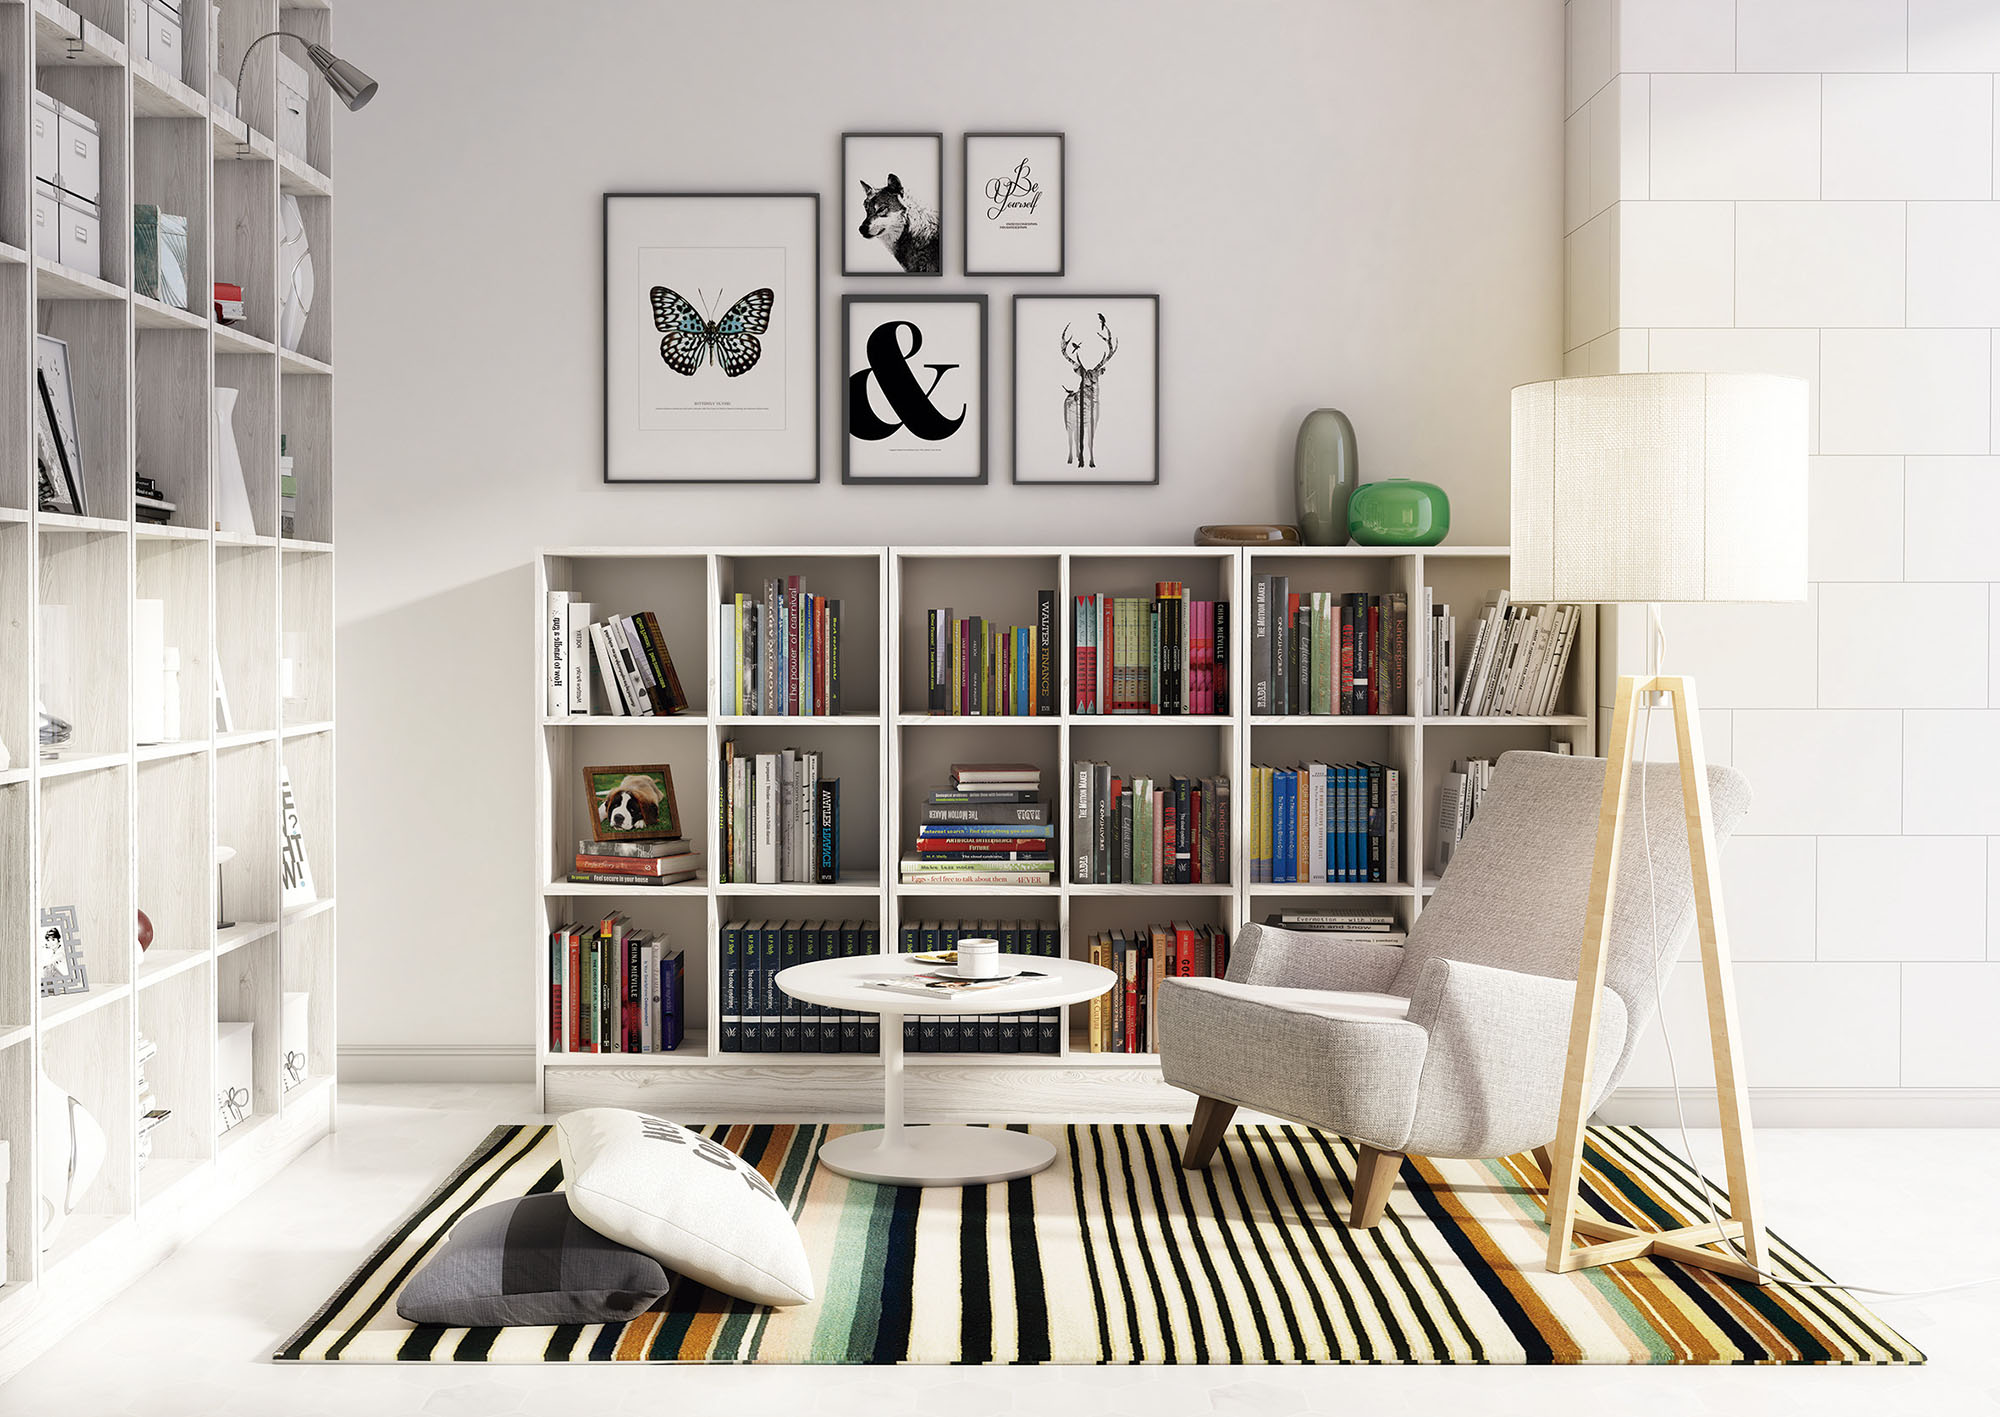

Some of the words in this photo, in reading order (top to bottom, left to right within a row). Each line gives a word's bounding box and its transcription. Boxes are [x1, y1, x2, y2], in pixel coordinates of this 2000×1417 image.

[788, 588, 797, 630] carnival
[1041, 601, 1049, 646] WALTER
[788, 633, 797, 645] of
[1394, 619, 1404, 689] Kindergarten
[789, 648, 799, 680] power
[1041, 647, 1049, 696] FINANCE
[788, 684, 797, 703] The
[1217, 801, 1227, 862] Kindergarten
[911, 876, 927, 884] Eggs
[974, 875, 991, 883] about
[631, 965, 639, 998] MIÉVILLE
